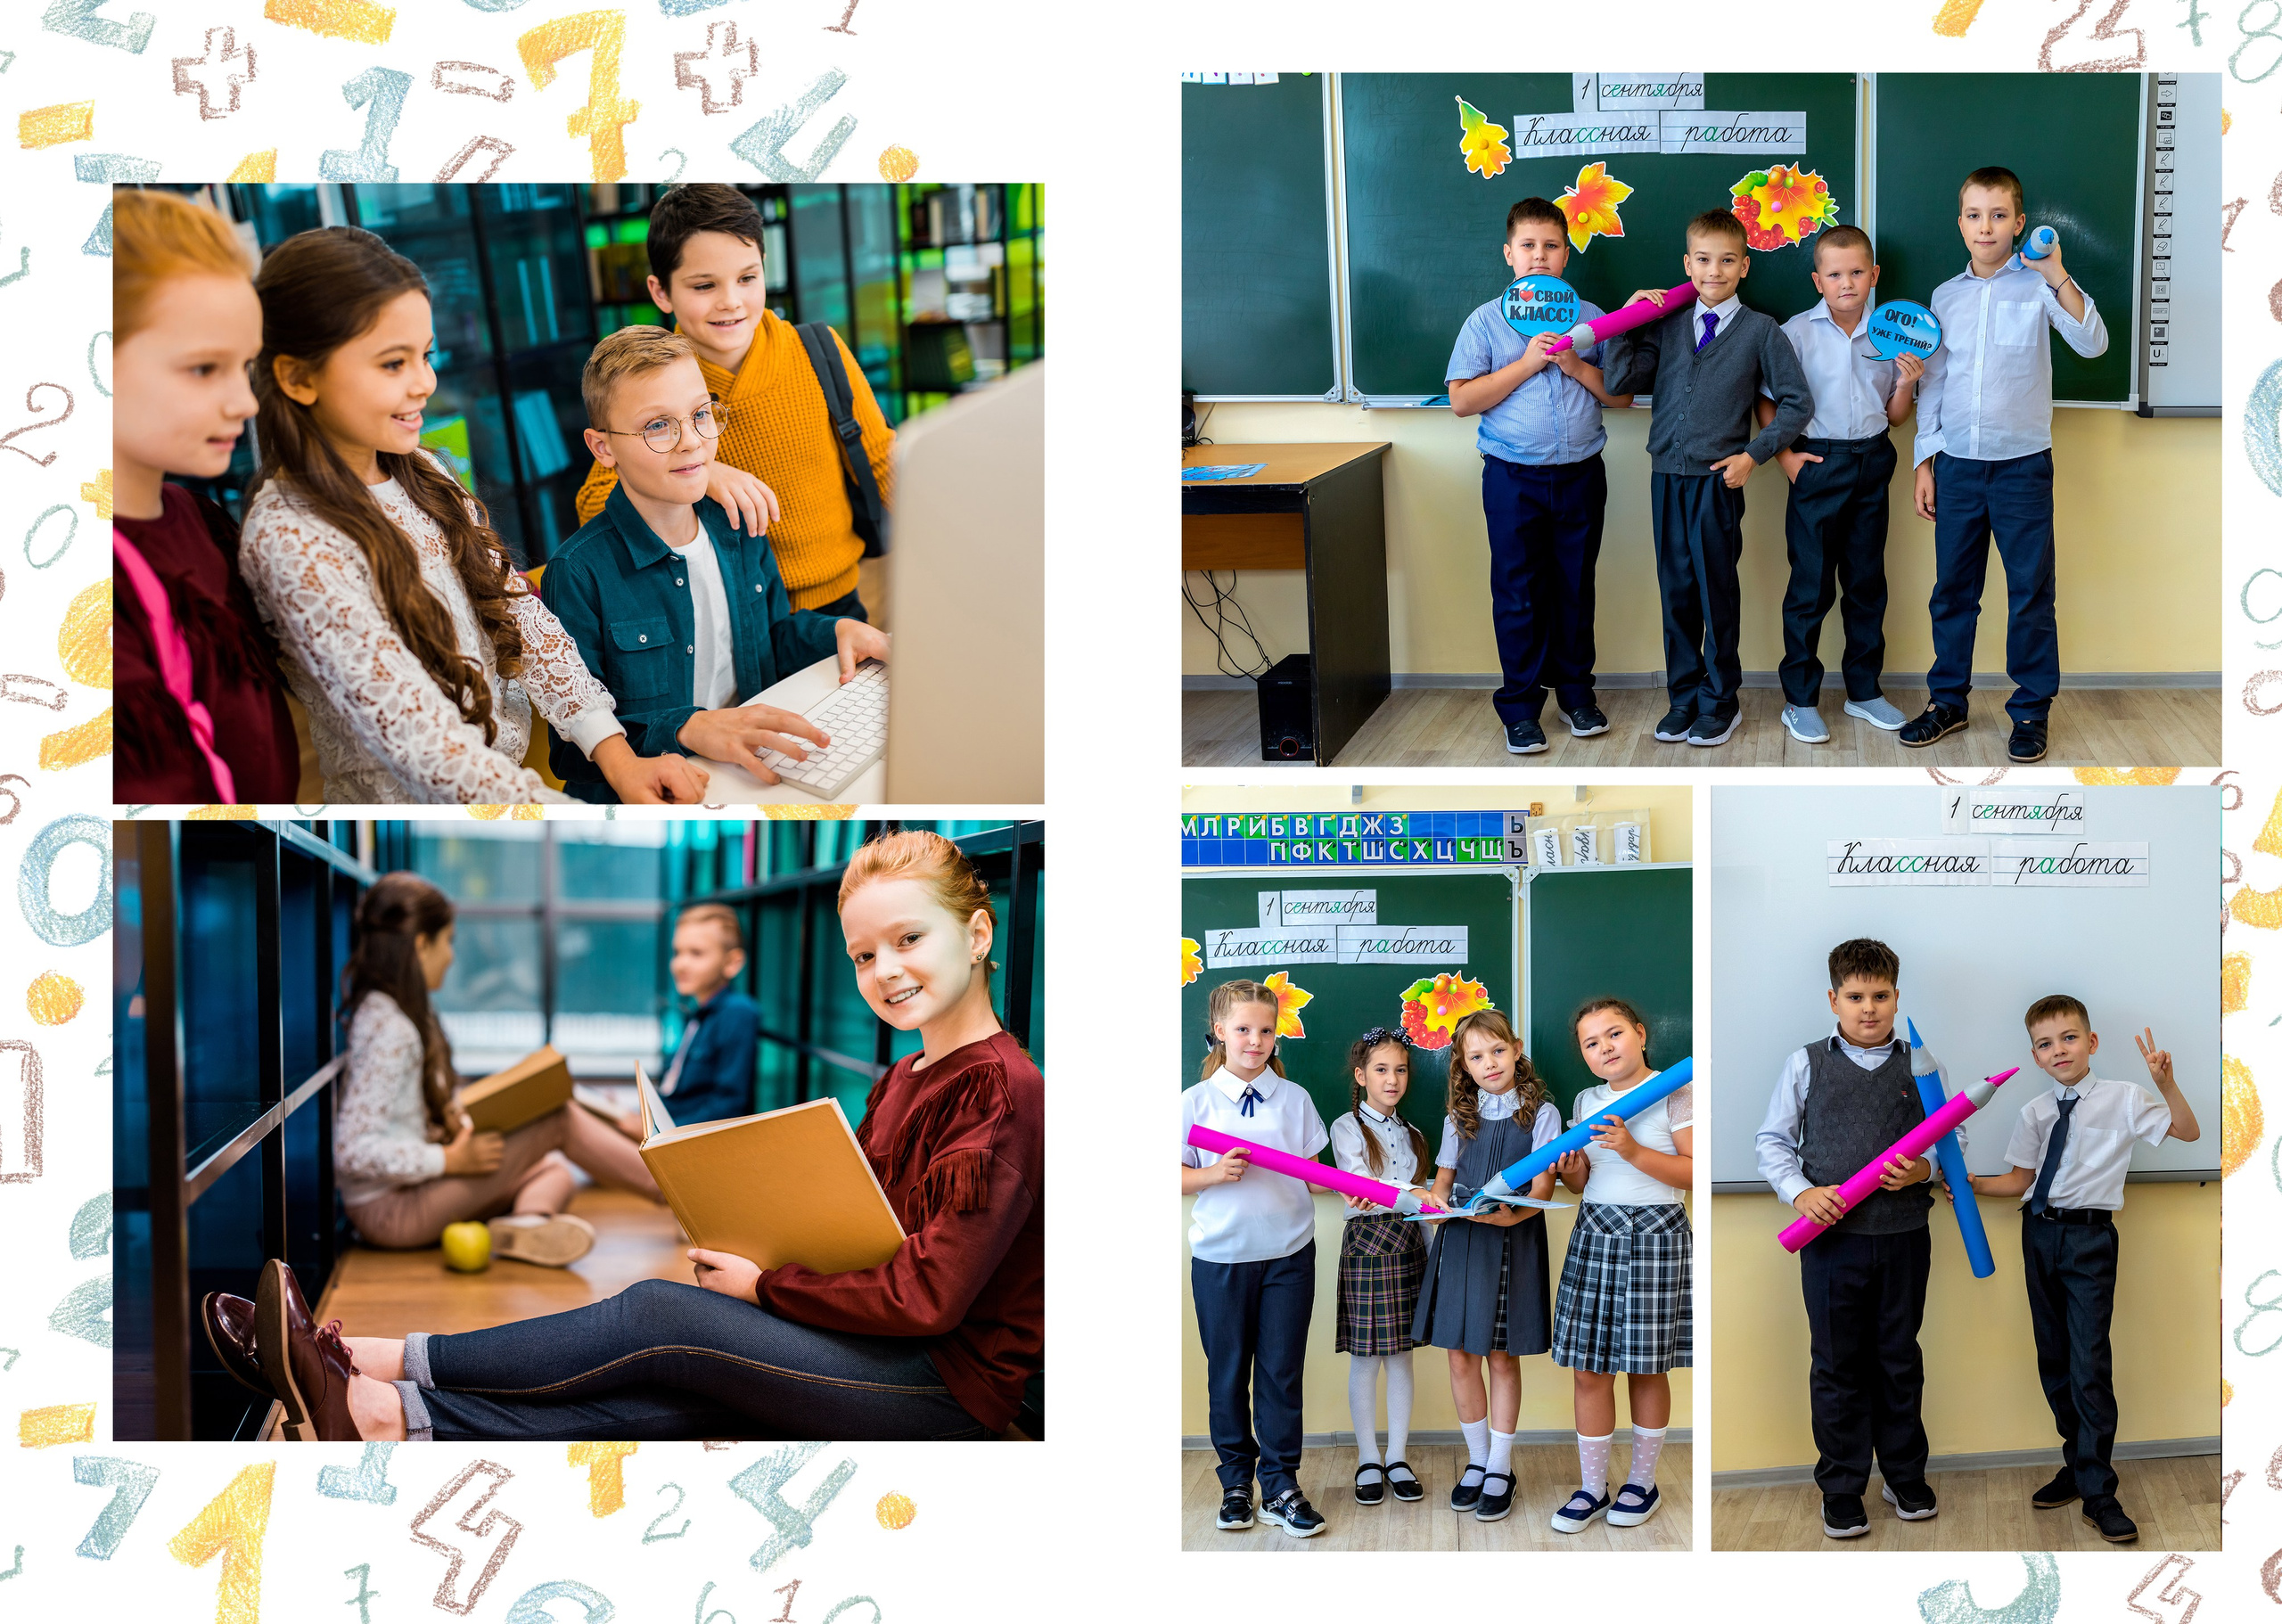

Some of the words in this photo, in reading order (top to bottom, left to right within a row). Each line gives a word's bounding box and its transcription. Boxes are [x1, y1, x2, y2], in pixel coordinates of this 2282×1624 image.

[1581, 78, 1591, 100] 1
[1601, 71, 1703, 107] сентября
[1523, 116, 1651, 146] Классная
[1680, 112, 1793, 152] работа
[1508, 288, 1520, 302] Я
[1534, 289, 1574, 304] СВОЙ
[1510, 305, 1574, 323] КЛАСС!
[1884, 308, 1918, 328] ОГО!
[1871, 326, 1892, 340] УЖЕ
[1894, 332, 1933, 351] ТРЕТИЙ?
[1788, 707, 1799, 725] FILA
[1950, 795, 1961, 819] 1
[1972, 793, 2083, 831] сентября
[1837, 841, 1981, 874] Классная
[2014, 842, 2135, 884] работа
[1266, 897, 1275, 916] 1
[1284, 890, 1375, 923] сентября
[1213, 931, 1329, 958] Классная
[1355, 927, 1456, 963] работа
[642, 1482, 691, 1545] 2
